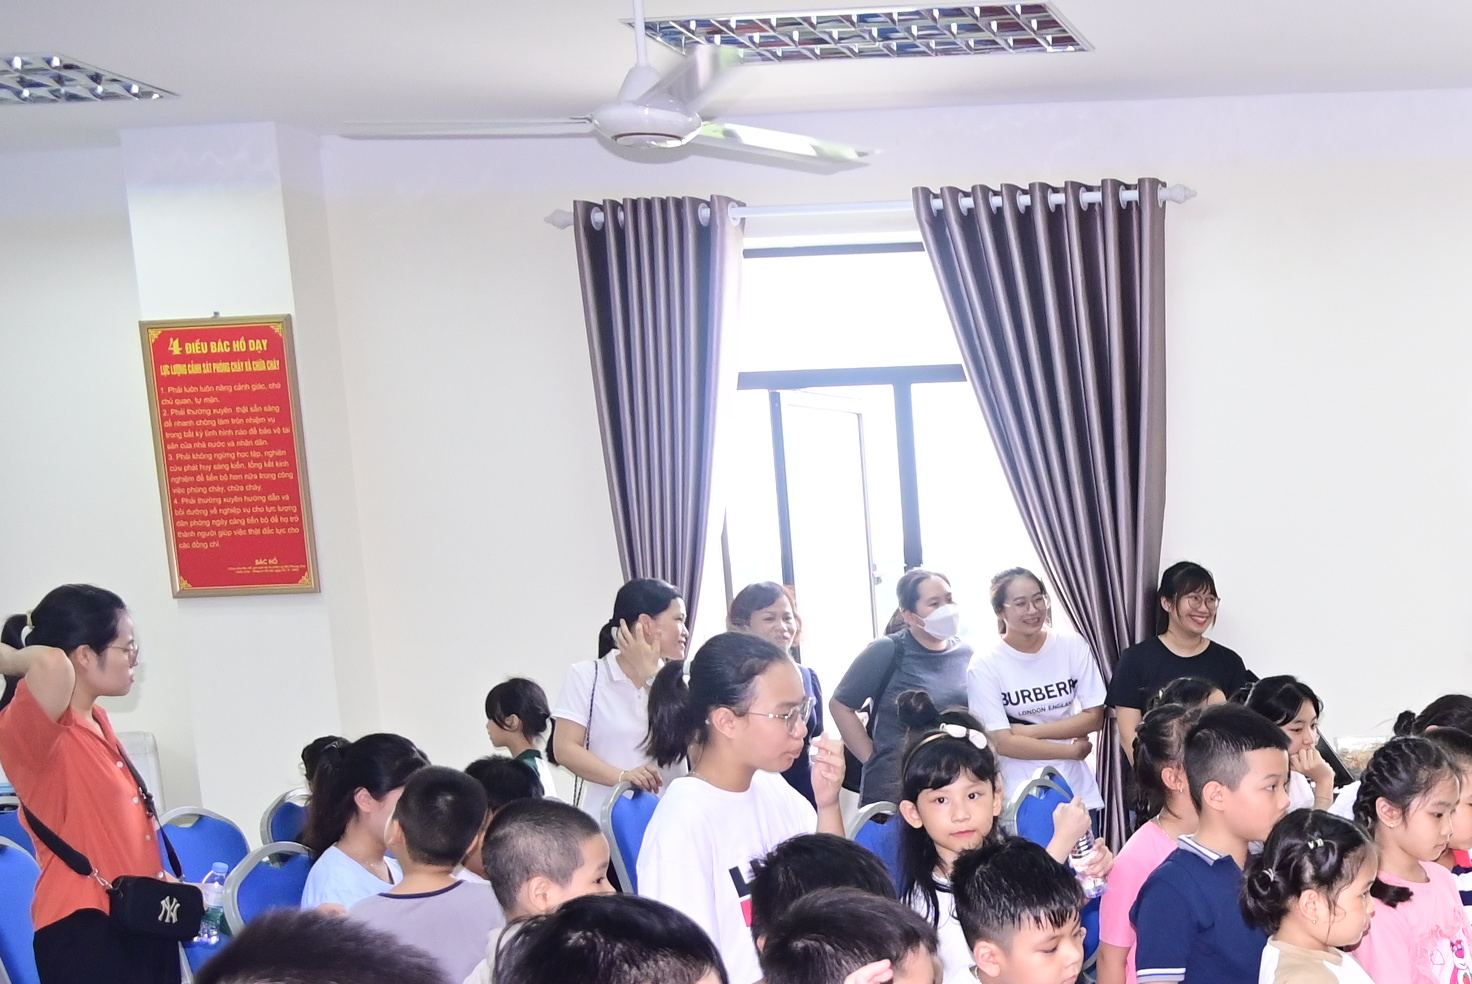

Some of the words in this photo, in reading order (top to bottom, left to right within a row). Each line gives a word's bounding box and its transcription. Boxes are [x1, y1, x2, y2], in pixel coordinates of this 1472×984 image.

[168, 337, 182, 355] 4
[210, 338, 231, 353] BÁC
[232, 336, 247, 352] HỒ
[248, 339, 268, 354] DẠY
[1018, 706, 1046, 717] LONDON
[1047, 701, 1072, 711] ENGLA
